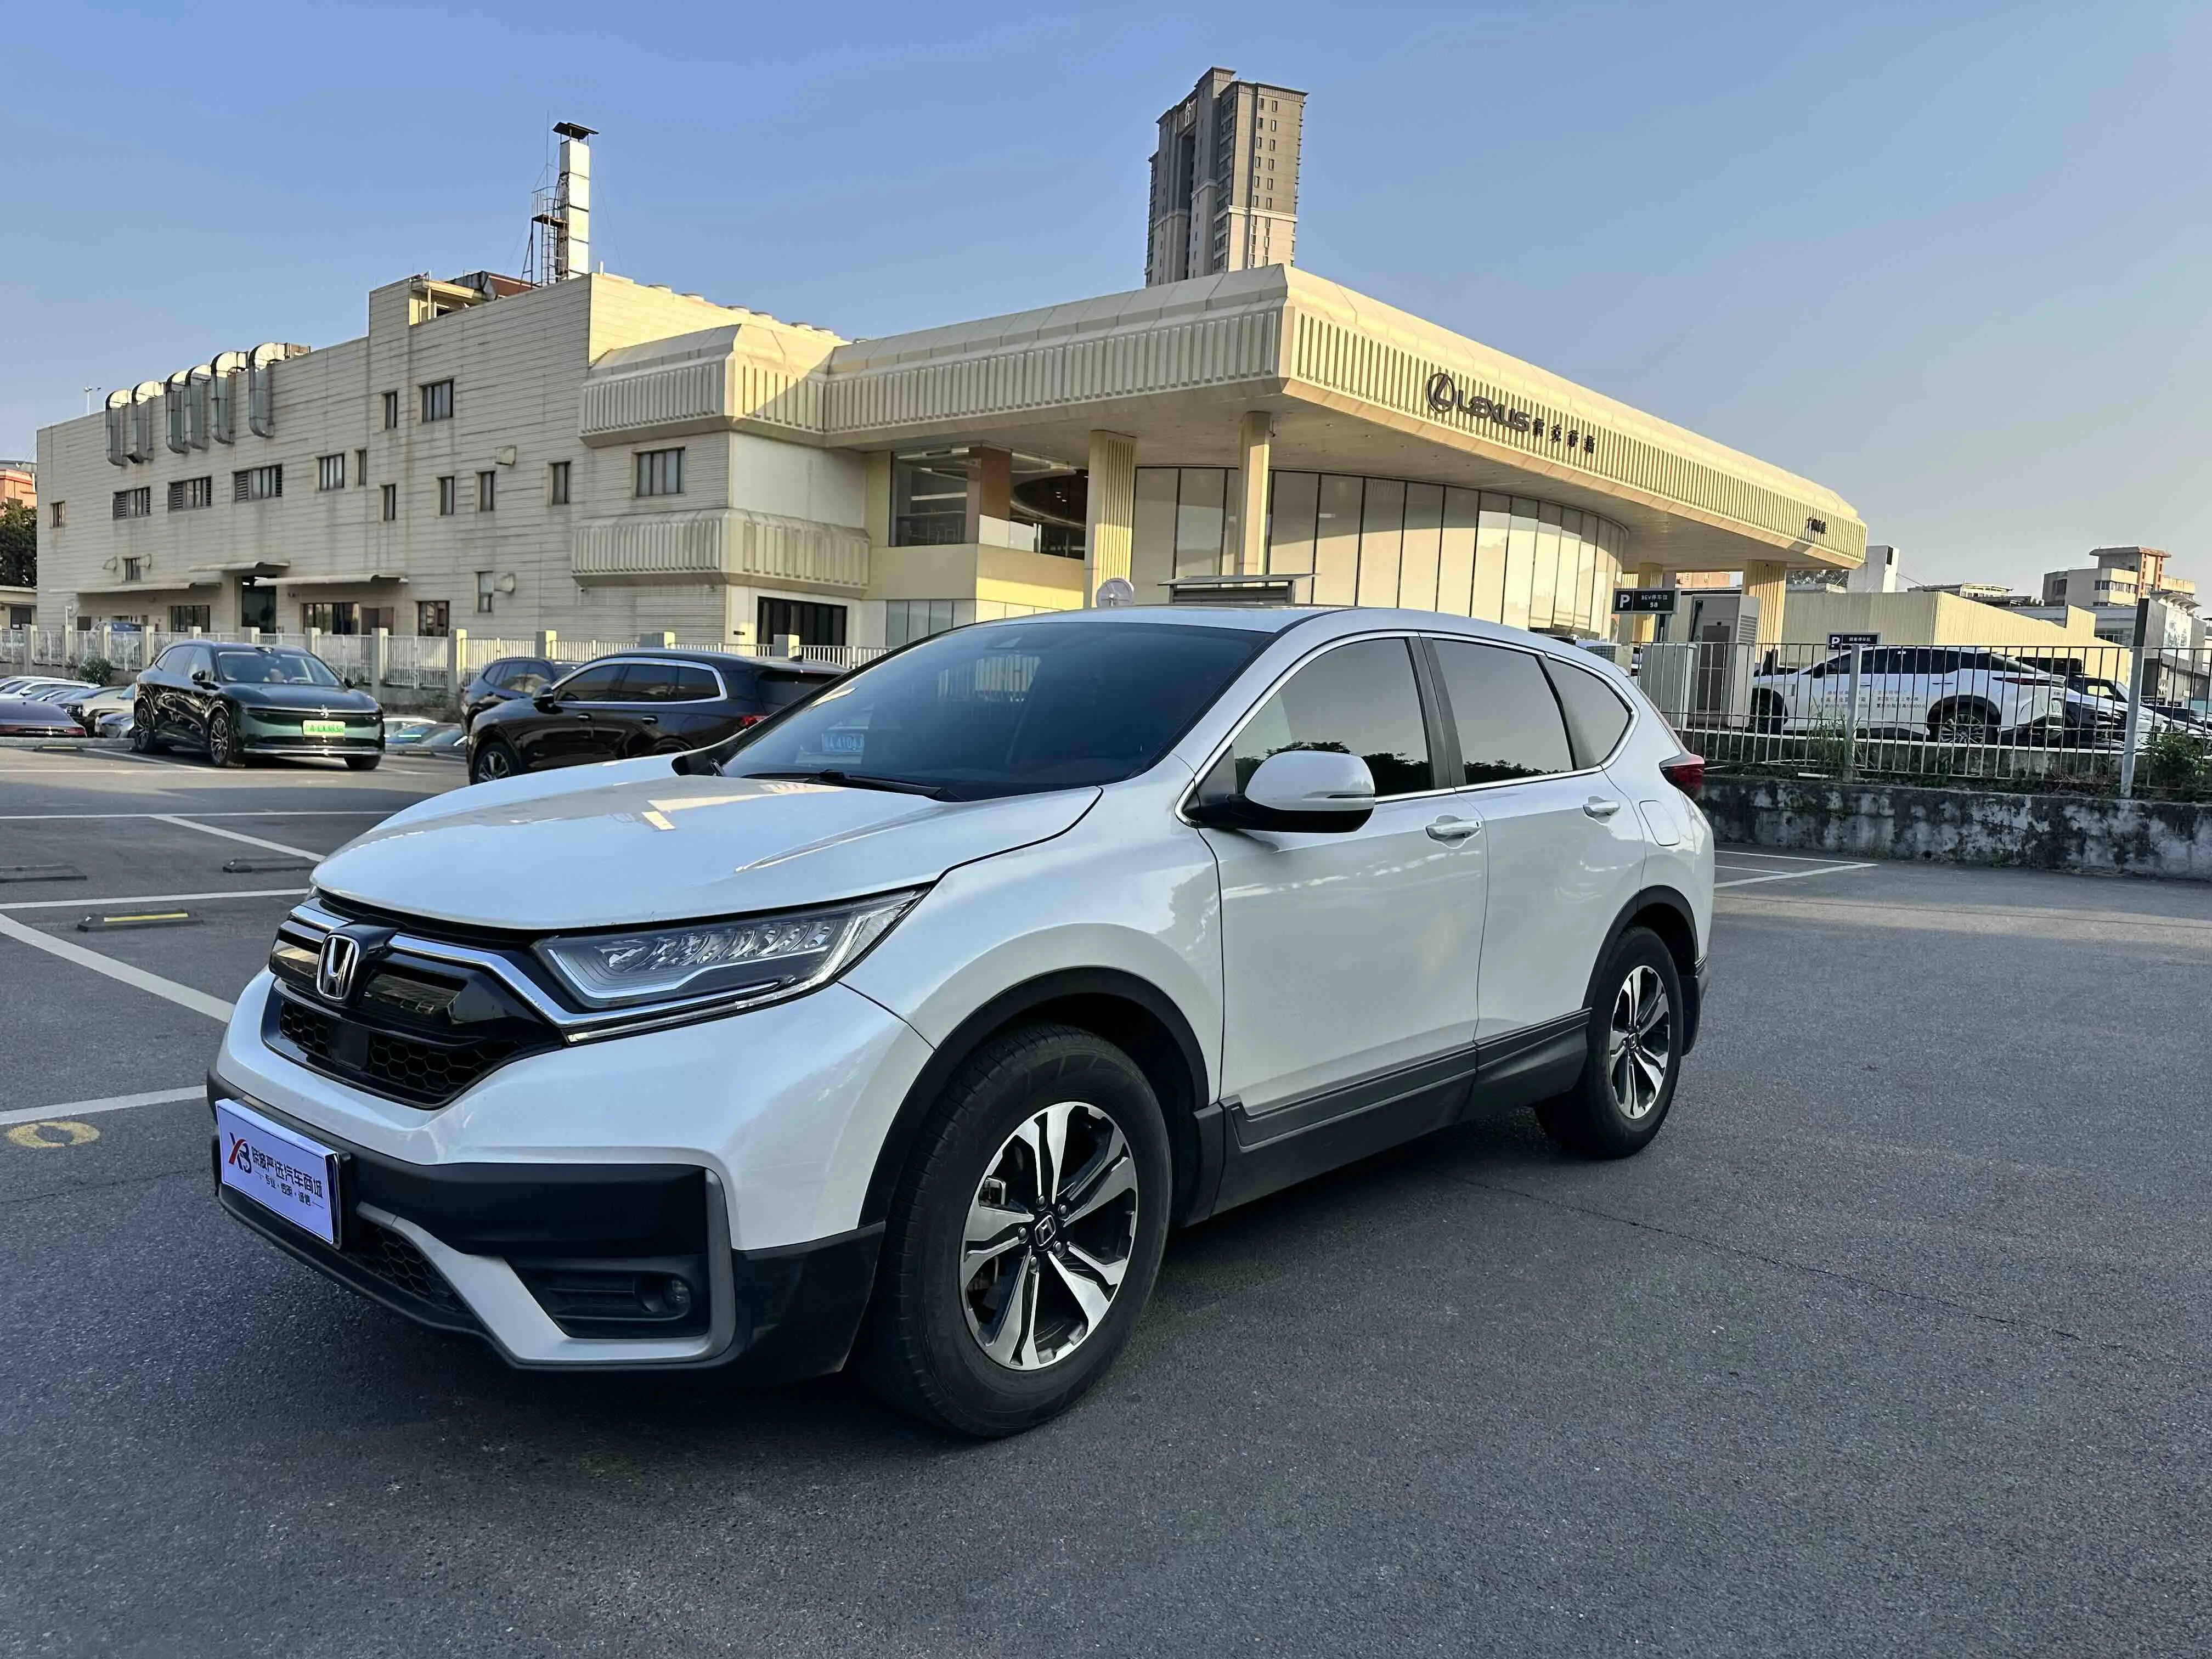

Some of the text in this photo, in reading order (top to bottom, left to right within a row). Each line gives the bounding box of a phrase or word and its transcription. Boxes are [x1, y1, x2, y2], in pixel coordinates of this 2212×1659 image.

[1457, 389, 1530, 432] LEXUS
[1620, 594, 1630, 608] P
[1831, 636, 1840, 647] P
